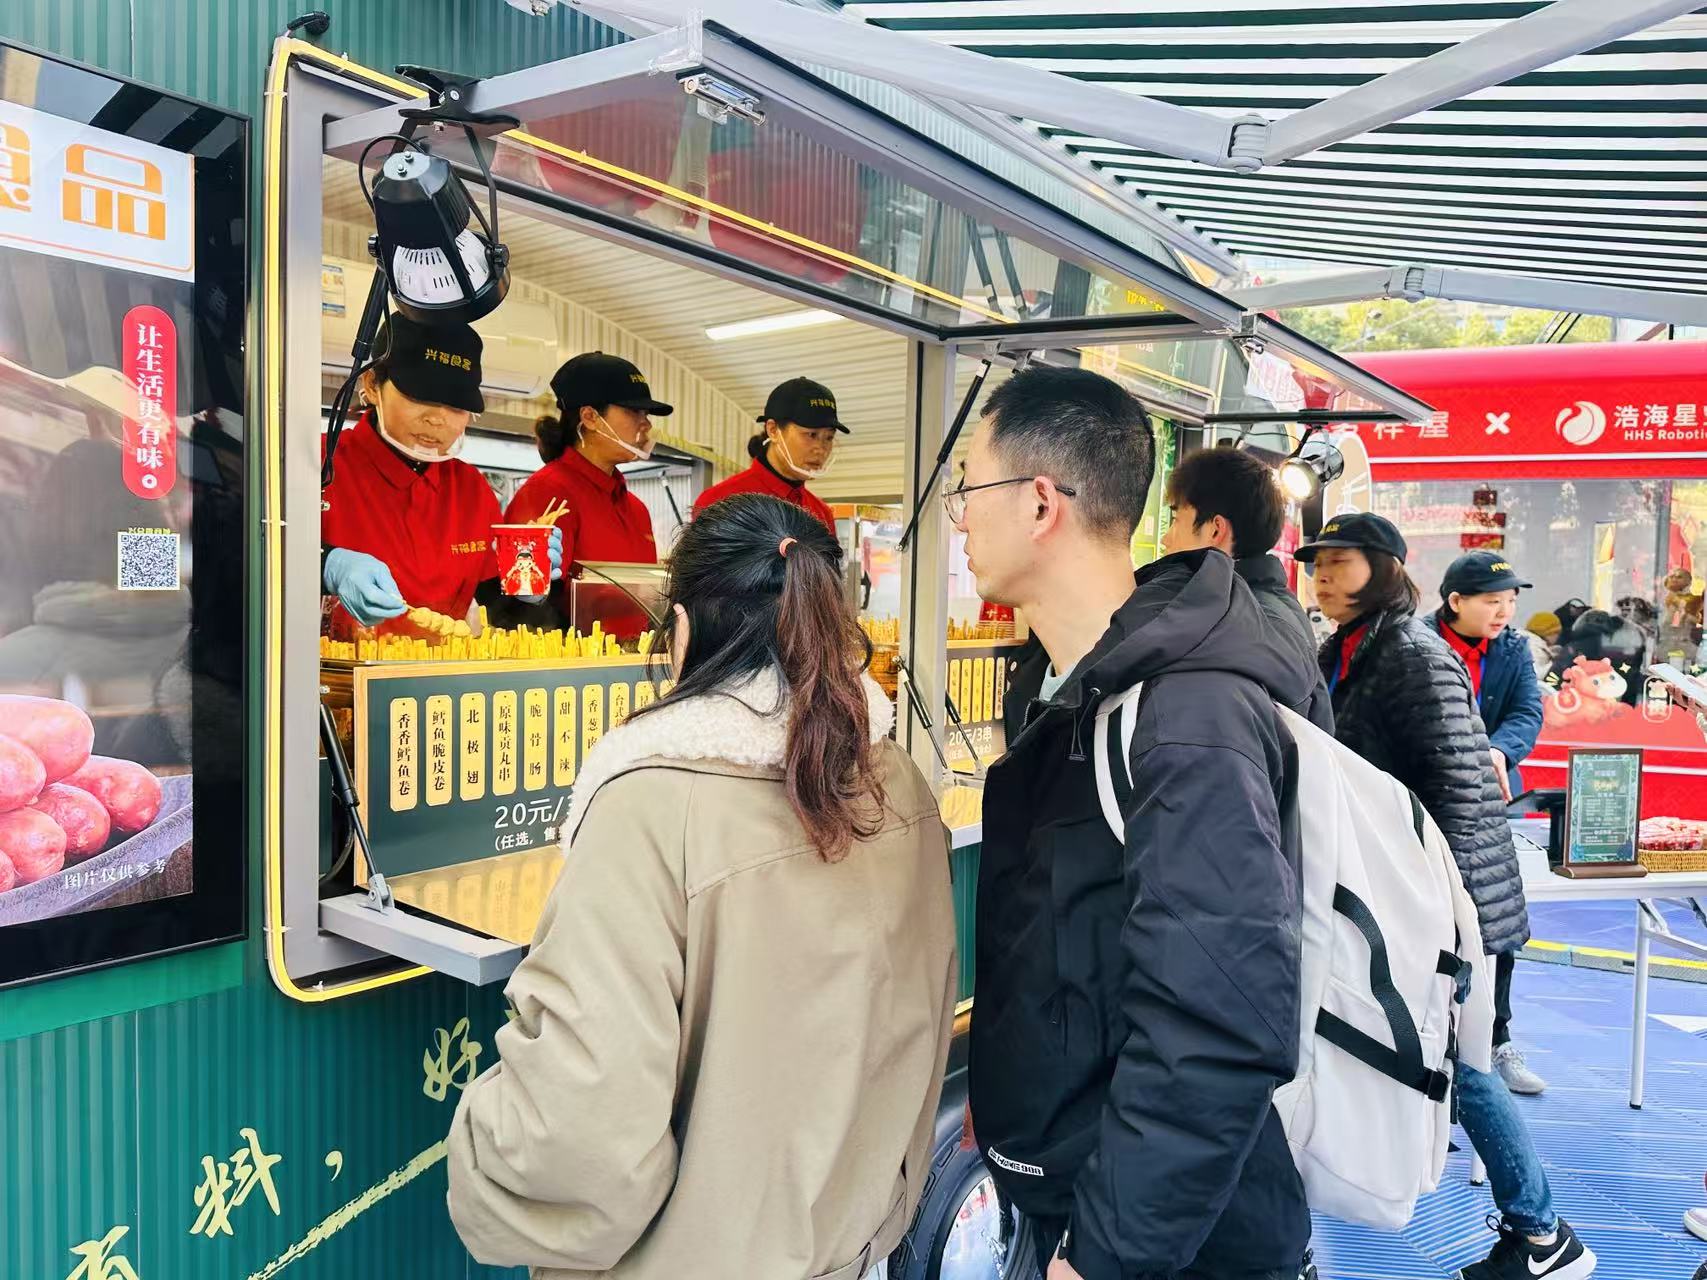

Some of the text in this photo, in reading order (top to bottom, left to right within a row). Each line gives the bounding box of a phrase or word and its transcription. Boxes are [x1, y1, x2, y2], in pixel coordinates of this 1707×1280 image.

[1613, 403, 1707, 429] 浩海星
[1624, 429, 1654, 441] HHS
[396, 713, 411, 796] 香香鳕鱼卷
[432, 710, 446, 791] 鳕鱼脆皮卷
[466, 708, 480, 785] 北极翅
[498, 704, 512, 782] 原味贡丸串
[529, 703, 542, 776] 脆骨肠
[559, 701, 571, 772] 甜不辣
[64, 858, 167, 890] 图片仅供参考
